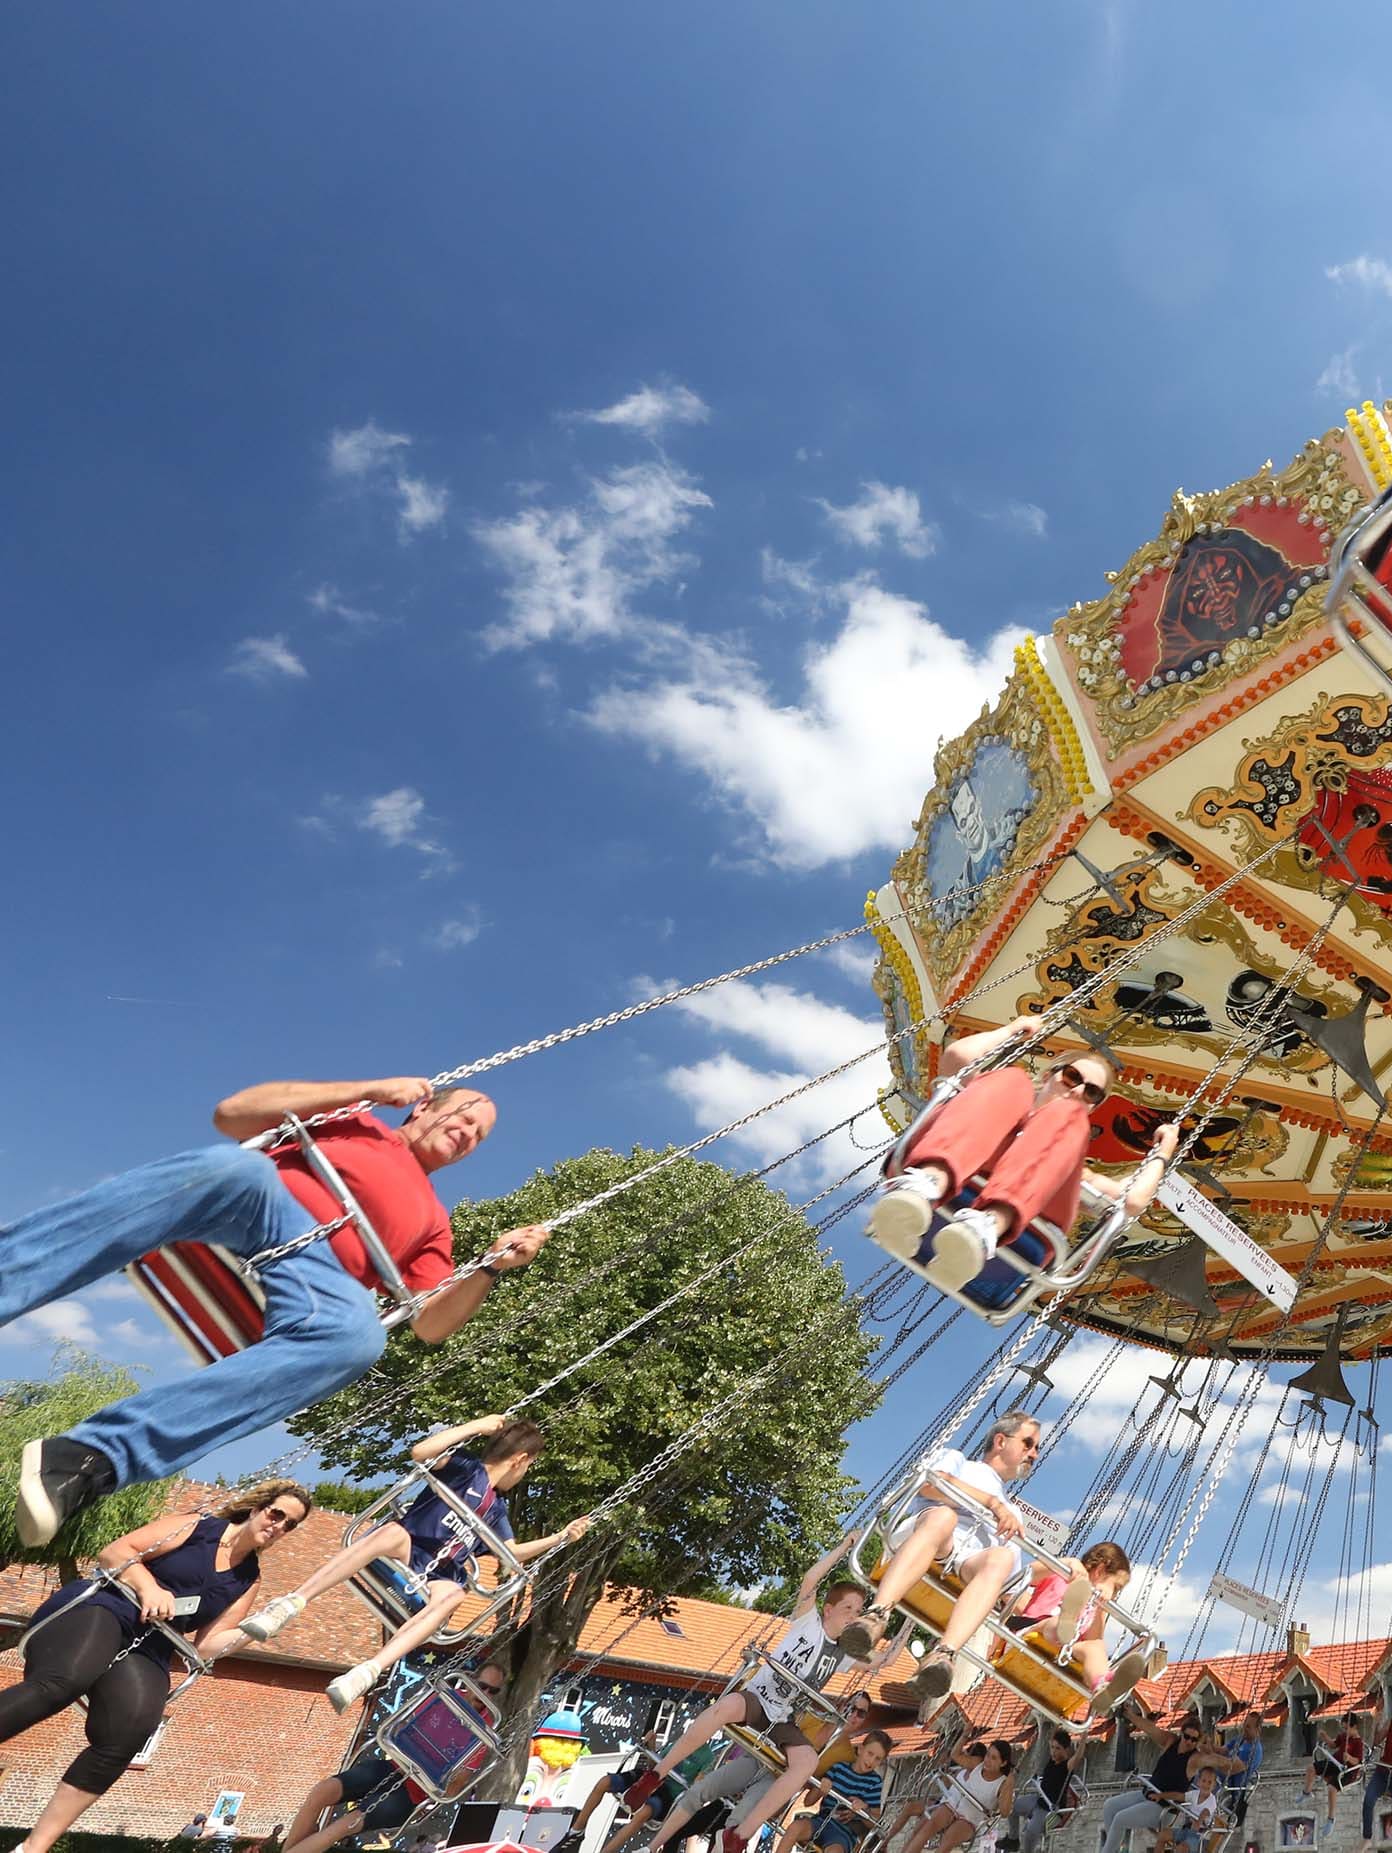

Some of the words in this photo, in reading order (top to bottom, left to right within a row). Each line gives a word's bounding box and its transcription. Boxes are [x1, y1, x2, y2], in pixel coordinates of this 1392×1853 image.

[1187, 1187, 1224, 1224] PLACES
[1225, 1221, 1279, 1274] RESERVEES
[1250, 1256, 1273, 1279] ENFANT
[592, 1706, 631, 1728] Miroirs
